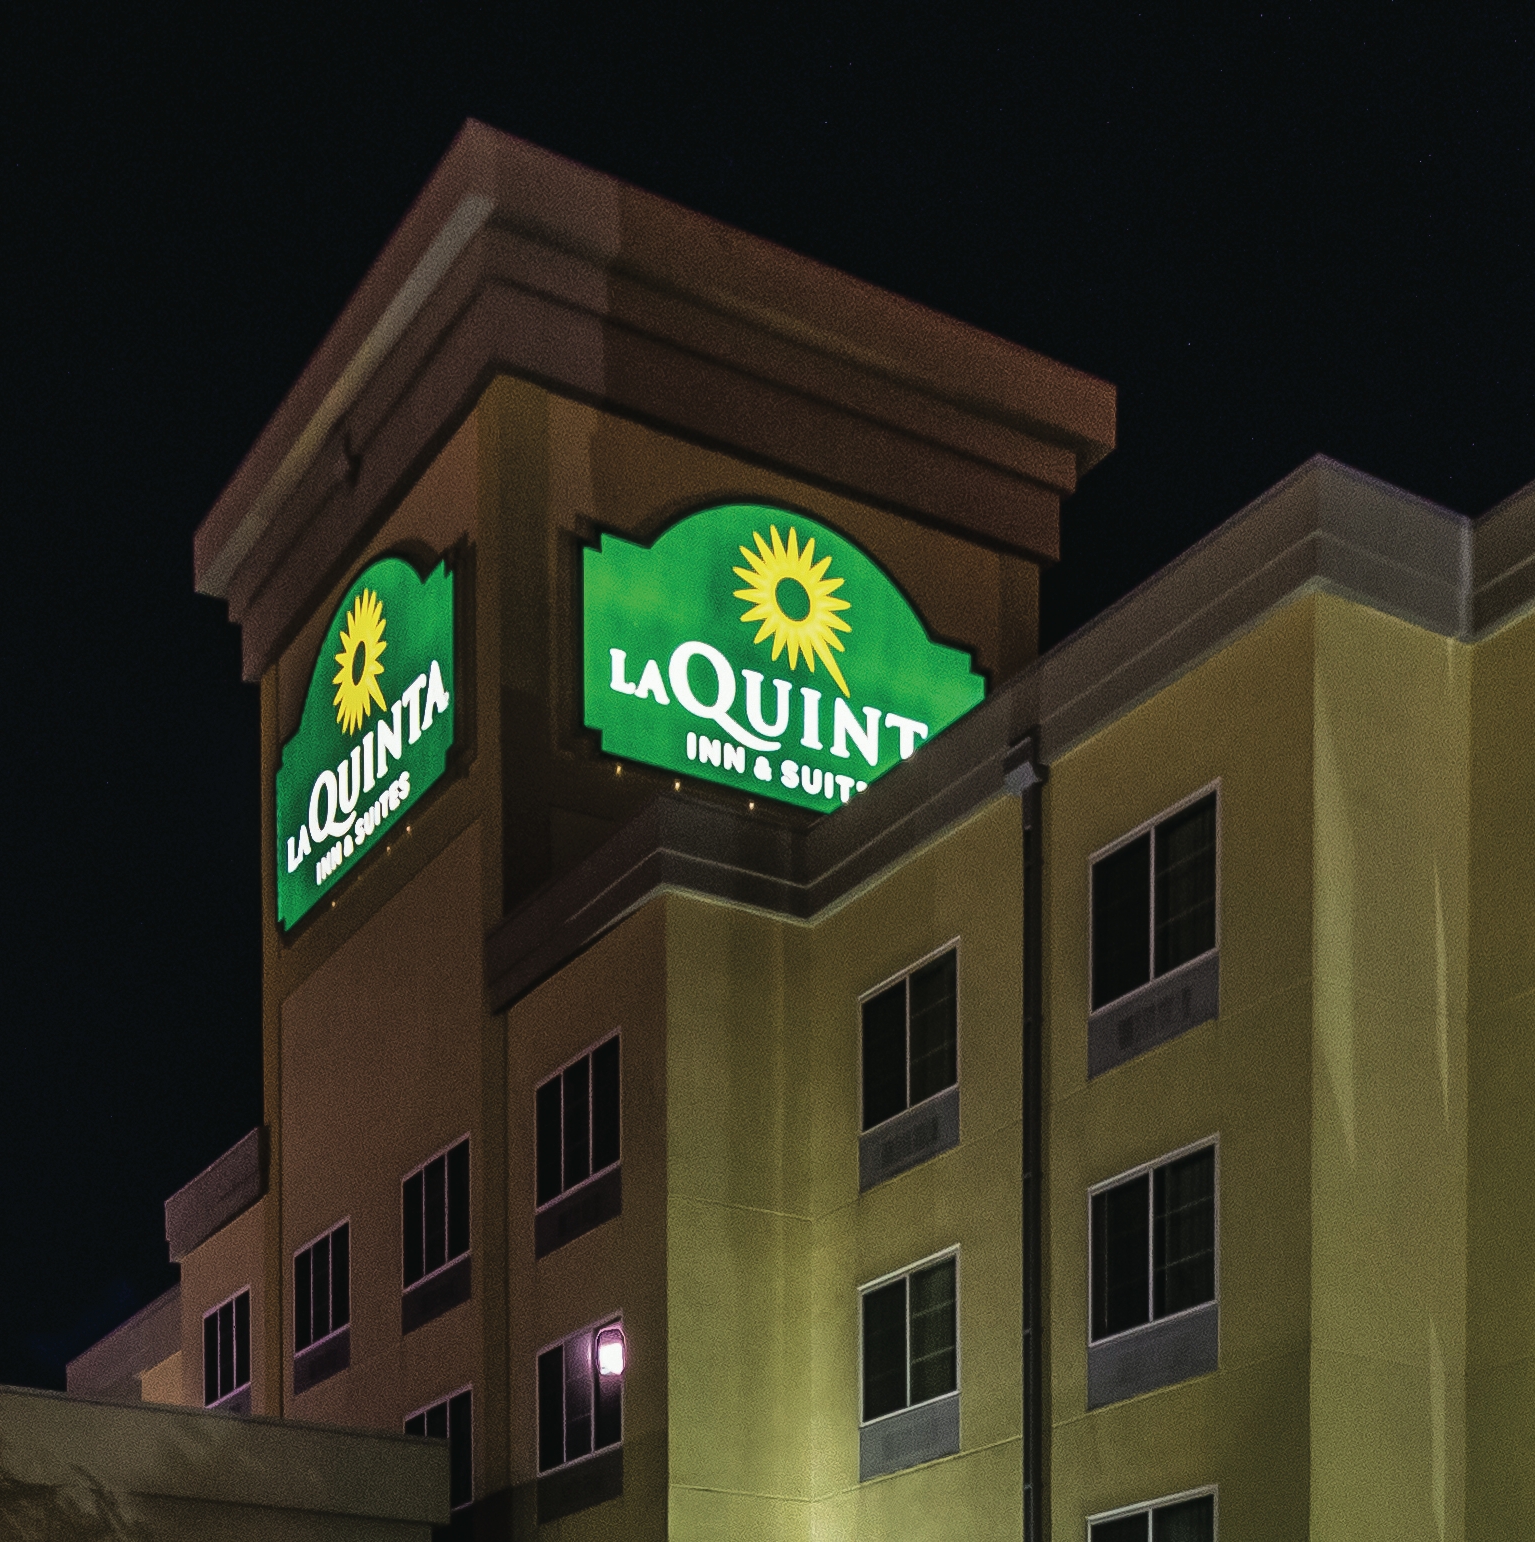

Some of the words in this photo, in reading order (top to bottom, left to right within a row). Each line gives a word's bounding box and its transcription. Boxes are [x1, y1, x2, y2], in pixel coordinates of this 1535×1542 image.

[609, 648, 671, 705] LA
[668, 640, 929, 767] QUINT
[286, 824, 312, 873] LA
[308, 659, 450, 843] QUINTA
[686, 731, 746, 774] INN
[753, 755, 773, 782] &
[780, 759, 868, 804] SUIT
[315, 840, 343, 886] INN
[354, 770, 411, 846] SUITES
